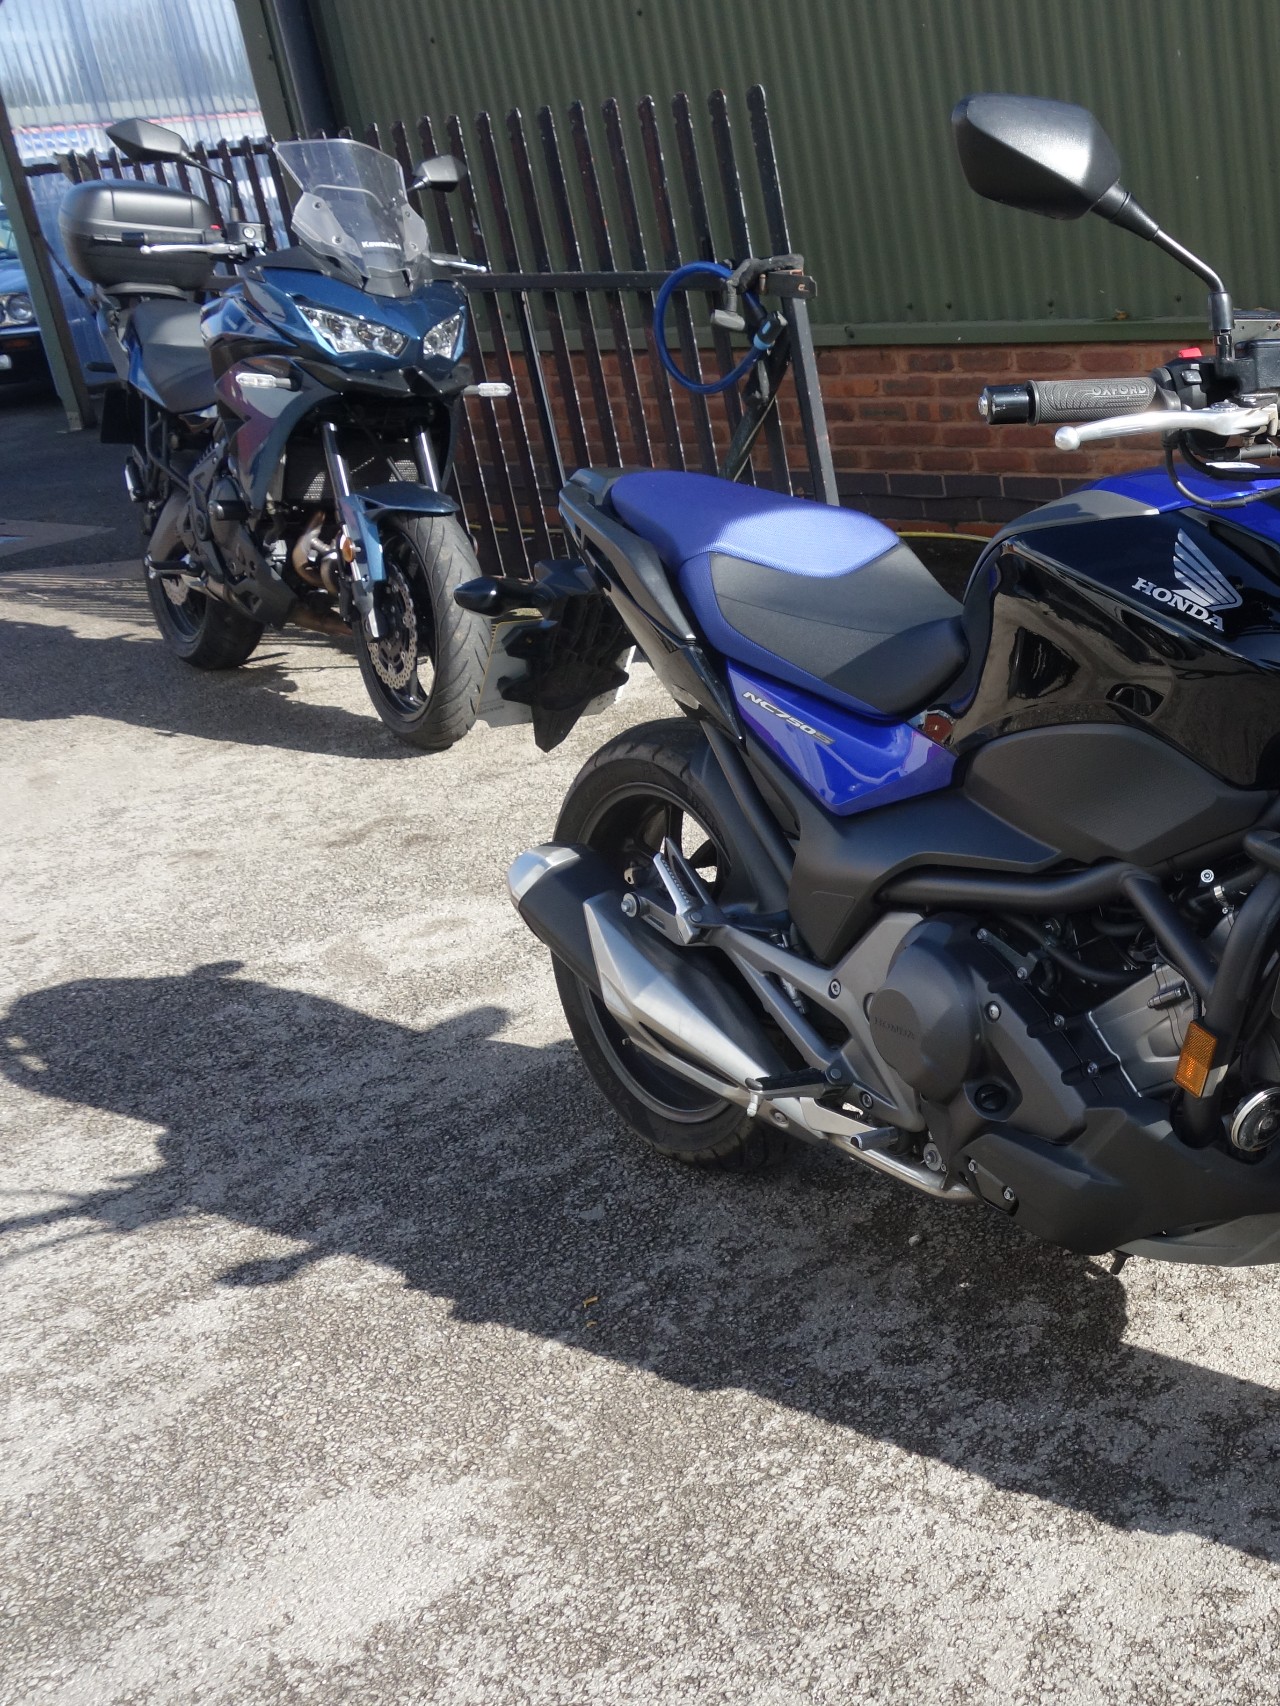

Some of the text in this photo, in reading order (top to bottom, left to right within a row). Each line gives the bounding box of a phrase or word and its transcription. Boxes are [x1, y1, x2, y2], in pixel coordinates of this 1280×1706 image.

[1092, 384, 1147, 396] OXFORD
[1132, 577, 1224, 632] HONDA
[743, 691, 836, 746] NC750S
